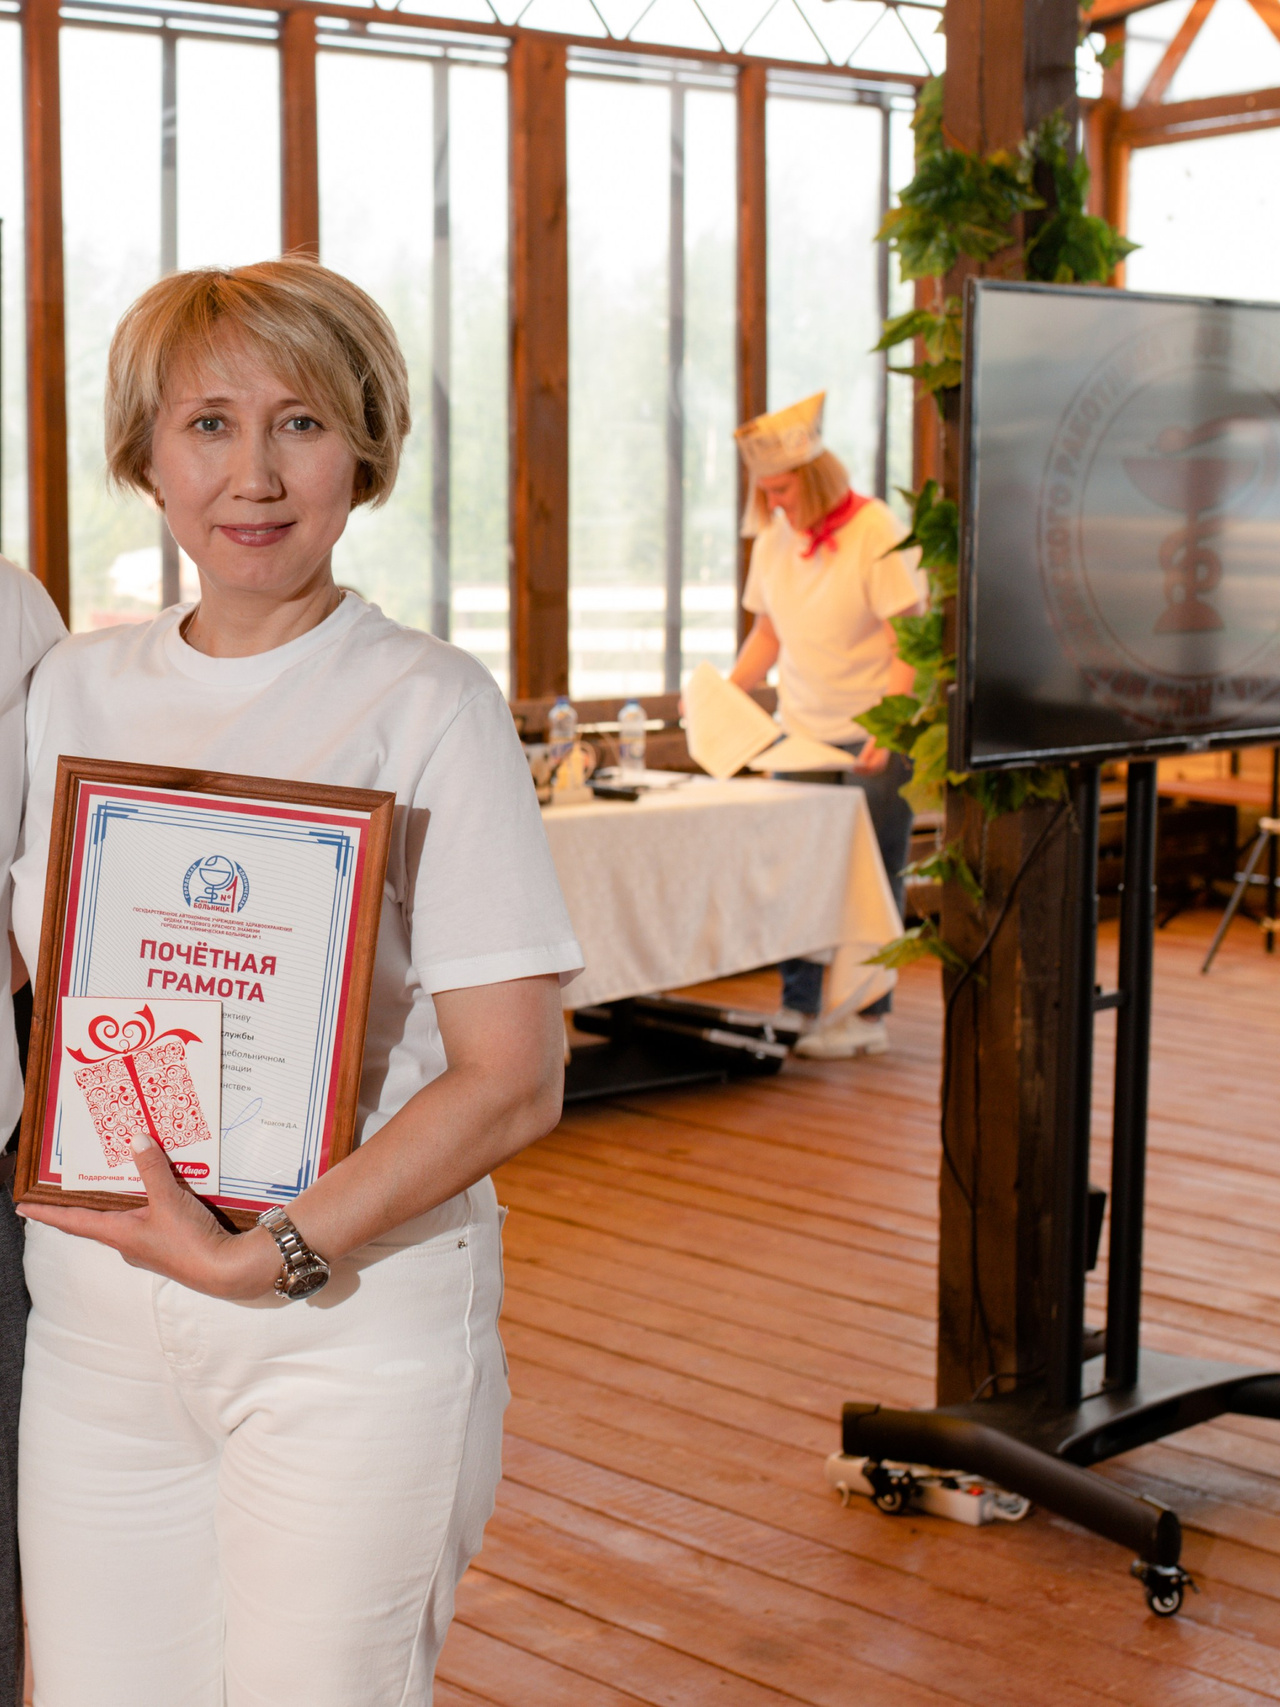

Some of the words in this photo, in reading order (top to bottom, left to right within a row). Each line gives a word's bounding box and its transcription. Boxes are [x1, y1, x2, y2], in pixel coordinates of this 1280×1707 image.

[193, 902, 230, 913] БОЛЬНИЦА
[132, 906, 178, 917] ГОСУДАРСТВЕННОЕ
[179, 913, 210, 922] АВТОНОМНОЕ
[211, 917, 245, 926] УЧРЕЖДЕНИЕ
[245, 922, 293, 932] ЗДРАВООХРАНЕНИЯ
[184, 919, 211, 928] ТРУДОВОГО
[211, 923, 236, 931] КРАСНОГО
[160, 922, 189, 931] ГОРОДСКАЯ
[189, 926, 225, 936] КЛИНИЧЕСКАЯ
[225, 930, 251, 939] БОЛЬНИЦА
[140, 939, 277, 976] ПОЧЁТНАЯ
[147, 968, 265, 1003] ГРАМОТА
[222, 1012, 251, 1023] ективу
[78, 1173, 125, 1182] Подарочная
